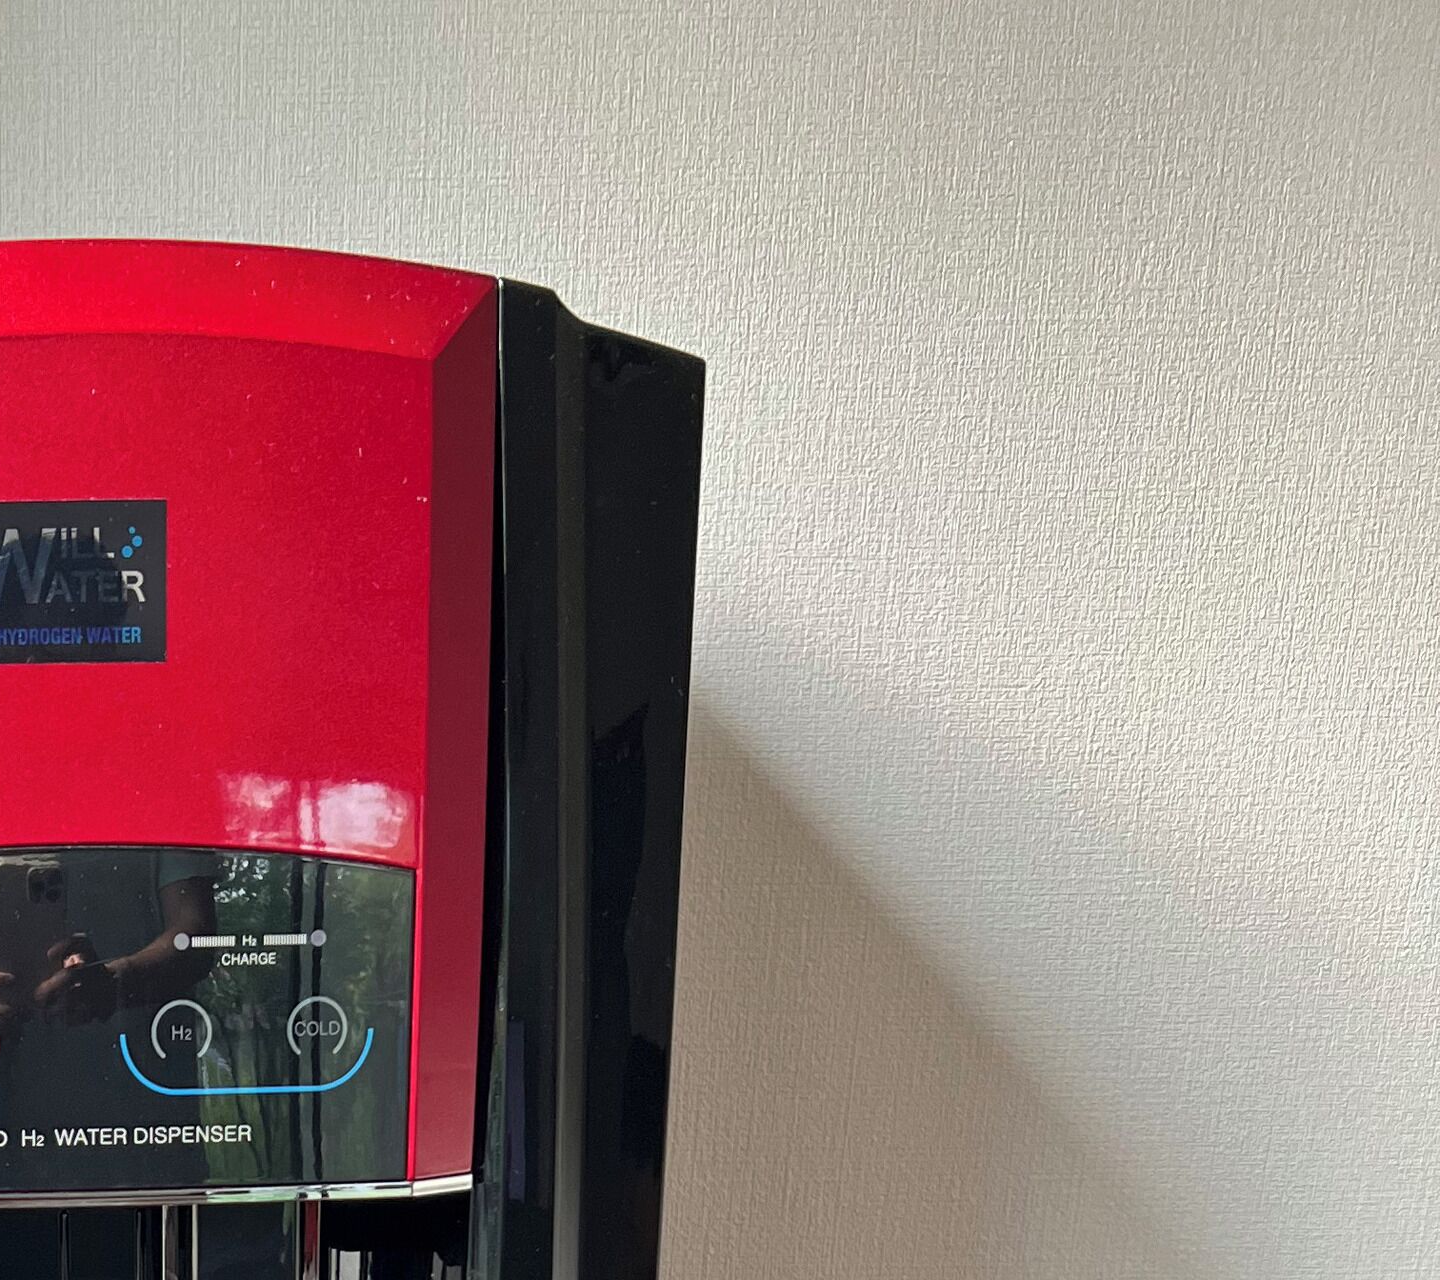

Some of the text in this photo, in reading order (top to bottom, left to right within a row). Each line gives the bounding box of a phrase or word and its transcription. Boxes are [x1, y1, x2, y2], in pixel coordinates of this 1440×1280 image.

[86, 626, 143, 646] WATER
[221, 952, 277, 966] CHARGE
[294, 1020, 341, 1037] COLD
[54, 1128, 127, 1147] WATER
[134, 1125, 252, 1145] DISPENSER
